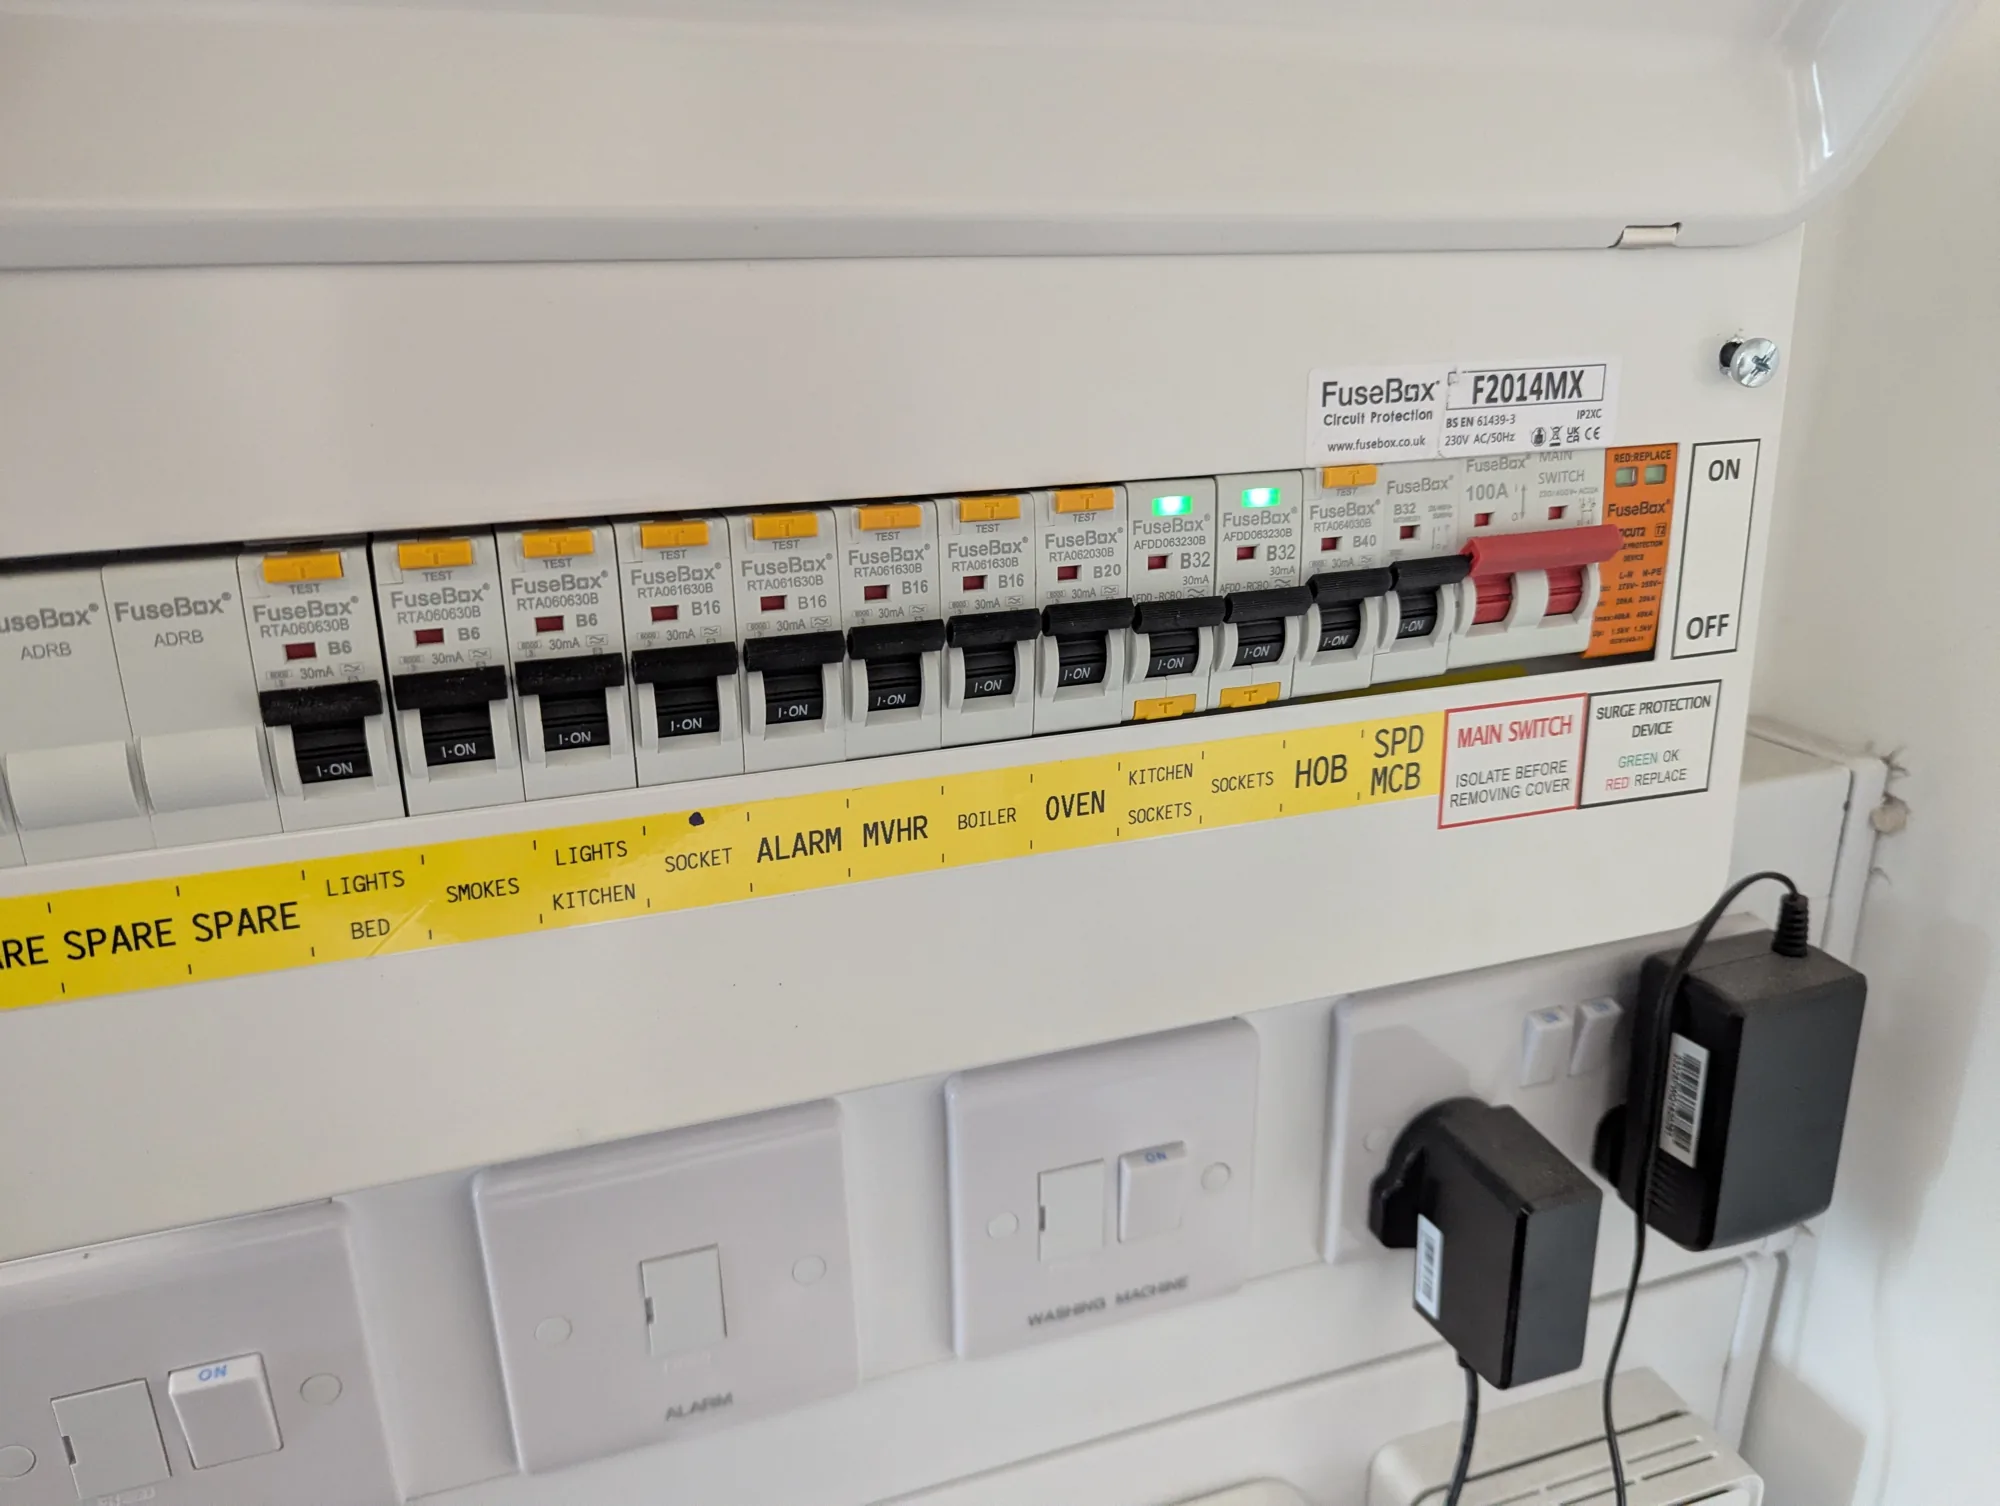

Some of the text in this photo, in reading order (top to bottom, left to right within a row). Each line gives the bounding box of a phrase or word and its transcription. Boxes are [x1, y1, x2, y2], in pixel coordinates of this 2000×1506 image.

[1472, 370, 1584, 405] F2014MX
[1324, 409, 1433, 427] Circuit Protection
[1446, 414, 1515, 428] BS EN 61439-3
[1577, 409, 1602, 420] IP2XC
[1328, 437, 1425, 452] www.fusebox.co.uk
[1445, 432, 1514, 446] 230V AC/50Hz
[1539, 451, 1573, 462] MAIN
[1538, 470, 1585, 484] SWITCH
[1708, 458, 1740, 482] ON
[1336, 487, 1358, 496] TEST
[1466, 483, 1508, 501] 100A
[1394, 503, 1416, 515] B32
[1073, 512, 1097, 523] TEST
[976, 524, 1000, 533] TEST
[1223, 528, 1292, 542] AFDD063230B
[876, 532, 900, 541] TEST
[1134, 536, 1206, 550] AFDD063230B
[1353, 535, 1376, 547] B40
[772, 540, 800, 550] TEST
[660, 550, 687, 560] TEST
[1049, 549, 1114, 562] RTA062030B
[1267, 545, 1295, 561] B32
[543, 558, 572, 569] TEST
[952, 557, 1019, 572] RTA061630B
[1180, 552, 1211, 570] B32
[1332, 559, 1353, 568] 30mA
[422, 571, 453, 582] TEST
[854, 563, 922, 577] RTA061630B
[1094, 564, 1121, 579] B20
[1270, 566, 1295, 576] 30mA
[747, 575, 823, 591] RTA061630B
[902, 580, 928, 595] B16
[999, 574, 1024, 588] B16
[1183, 576, 1209, 585] 30mA
[638, 583, 713, 598] RTA061630B
[1072, 588, 1096, 599] 30mA
[517, 593, 599, 610] RTA060630B
[692, 600, 721, 616] B16
[798, 595, 827, 610] B16
[975, 600, 1000, 610] 30mA
[576, 613, 598, 627] B6
[879, 609, 904, 618] 30mA
[777, 620, 806, 632] 30mA
[1686, 614, 1730, 640] OFF
[154, 630, 204, 647] ADRB
[458, 628, 480, 641] B6
[666, 630, 695, 641] 30mA
[20, 642, 72, 660] ADRB
[328, 641, 352, 655] B6
[549, 638, 580, 650] 30mA
[432, 652, 464, 665] 30mA
[1597, 695, 1711, 720] SURGE PROTECTION
[1457, 714, 1572, 749] MAIN SWITCH
[1632, 721, 1673, 738] DEVICE
[1374, 725, 1424, 758] SPD
[1618, 750, 1678, 768] GREEN OK
[1129, 763, 1193, 785] KITCHEN
[1295, 754, 1348, 788] HOB
[1456, 760, 1567, 789] ISOLATE BEFORE
[1211, 771, 1274, 794] SOCKETS
[1371, 763, 1421, 796] MCB
[1605, 768, 1687, 791] RED REPLACE
[1450, 778, 1570, 808] REMOVING COVER
[1046, 790, 1106, 821] OVEN
[958, 807, 1016, 830] BOILER
[1128, 802, 1192, 825] SOCKETS
[863, 815, 928, 847] MVHR
[556, 840, 628, 866] LIGHTS
[757, 827, 842, 864] ALARM
[665, 847, 732, 873] SOCKET
[327, 870, 405, 897] LIGHTS
[447, 878, 520, 903] SMOKES
[553, 883, 636, 911] KITCHEN
[64, 918, 176, 961] SPARE
[192, 901, 300, 943] SPARE
[351, 918, 391, 940] BED
[1145, 1151, 1167, 1163] ON
[1028, 1276, 1188, 1326] WASHING MACHINE
[199, 1364, 228, 1382] ON
